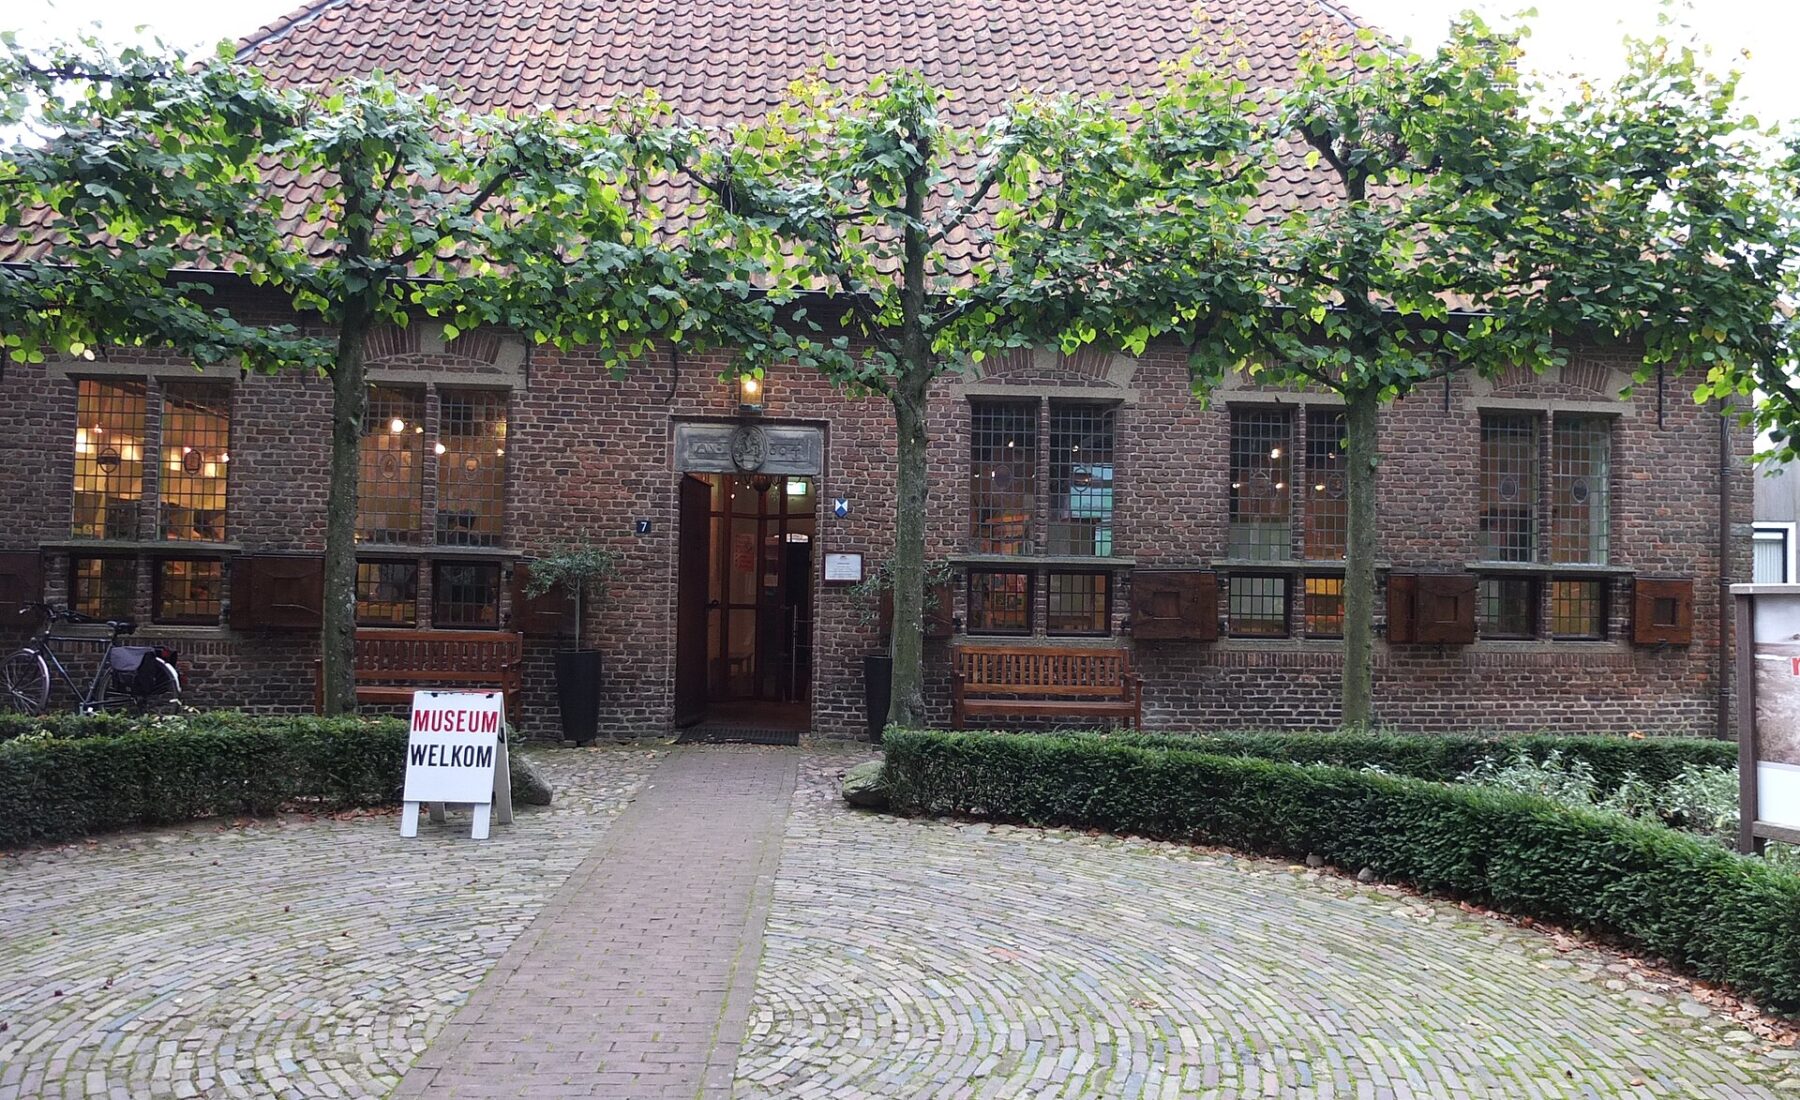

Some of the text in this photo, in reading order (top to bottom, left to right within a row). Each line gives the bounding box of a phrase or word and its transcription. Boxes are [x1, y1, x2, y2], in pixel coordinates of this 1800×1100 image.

[640, 521, 648, 532] 7
[413, 709, 498, 733] MUSEUM
[410, 744, 493, 768] WELKOM
